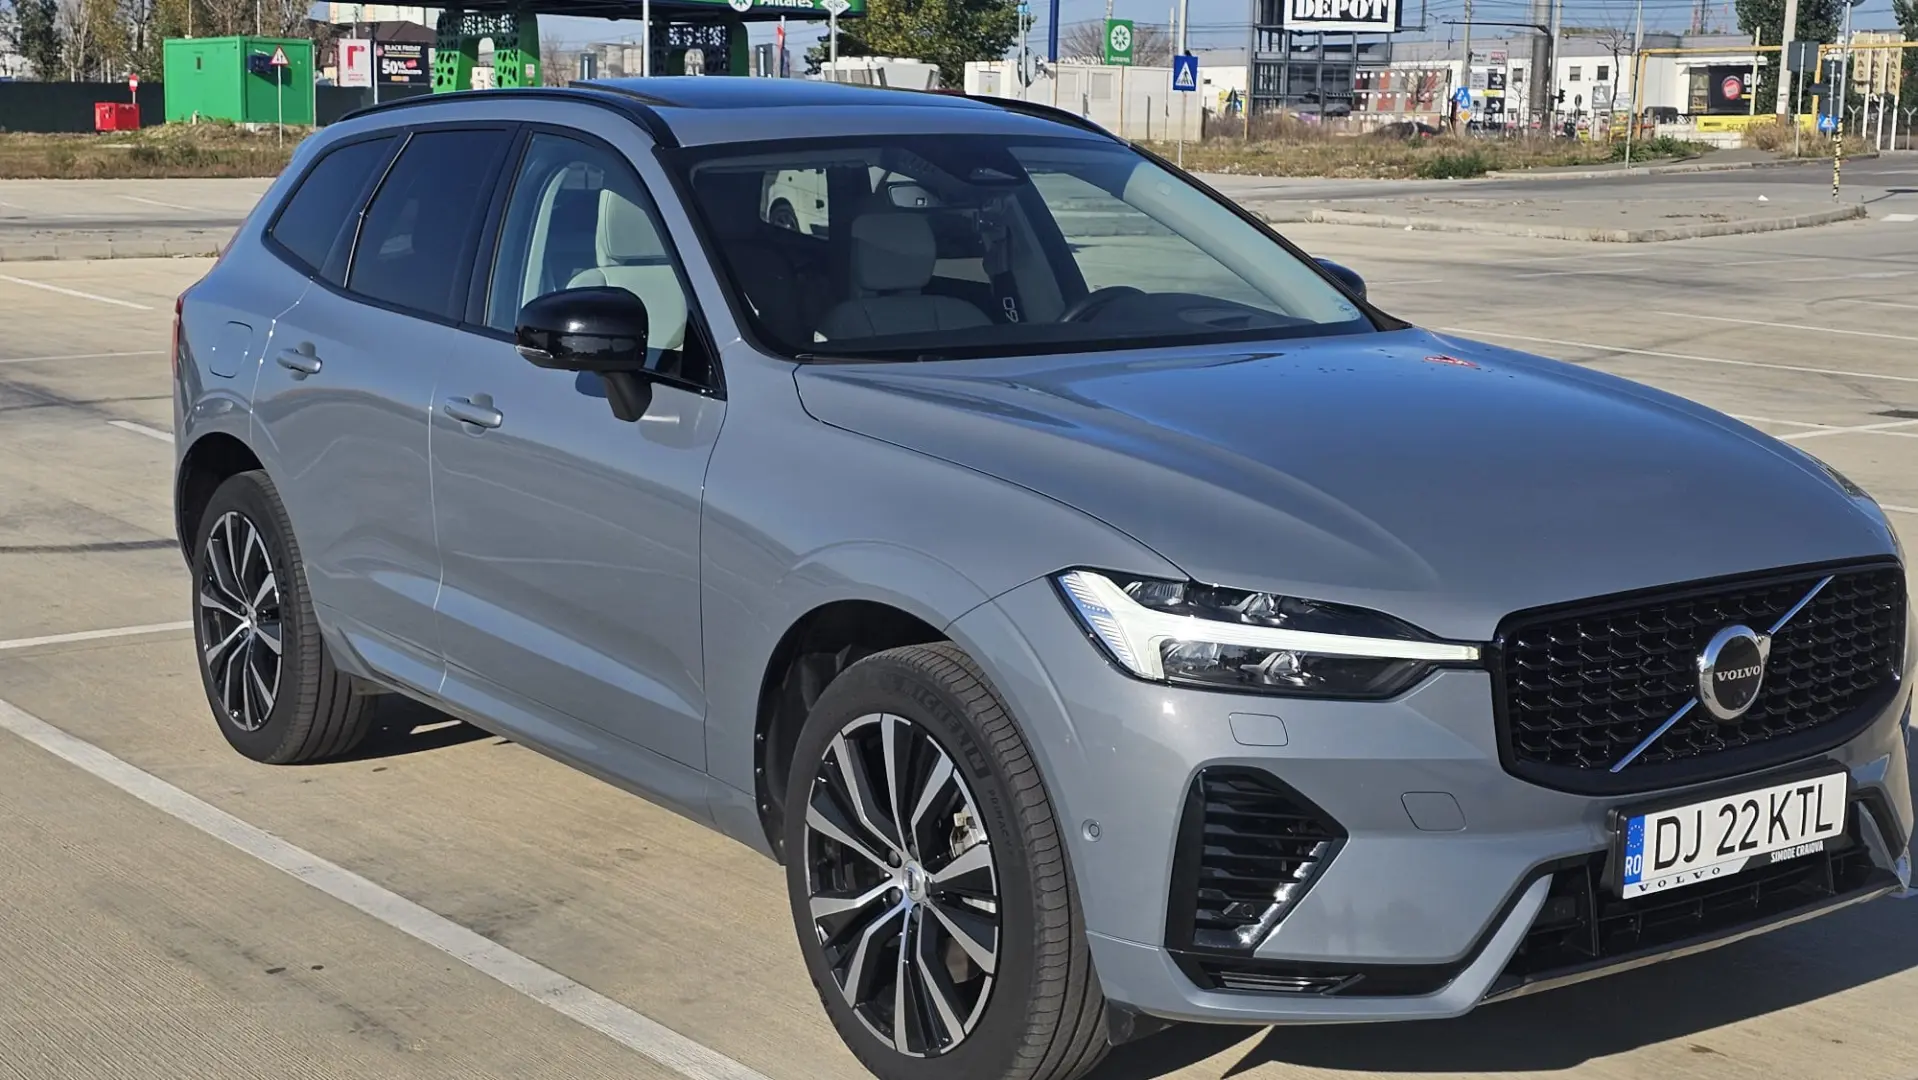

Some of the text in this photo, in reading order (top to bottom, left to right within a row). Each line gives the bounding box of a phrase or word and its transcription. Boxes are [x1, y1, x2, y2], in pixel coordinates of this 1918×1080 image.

[1294, 0, 1387, 19] DEPOT
[1716, 665, 1761, 682] VOLVO
[1653, 783, 1834, 871] DJ 22 KTL
[1624, 854, 1642, 877] RO
[1637, 866, 1721, 892] VOLVO
